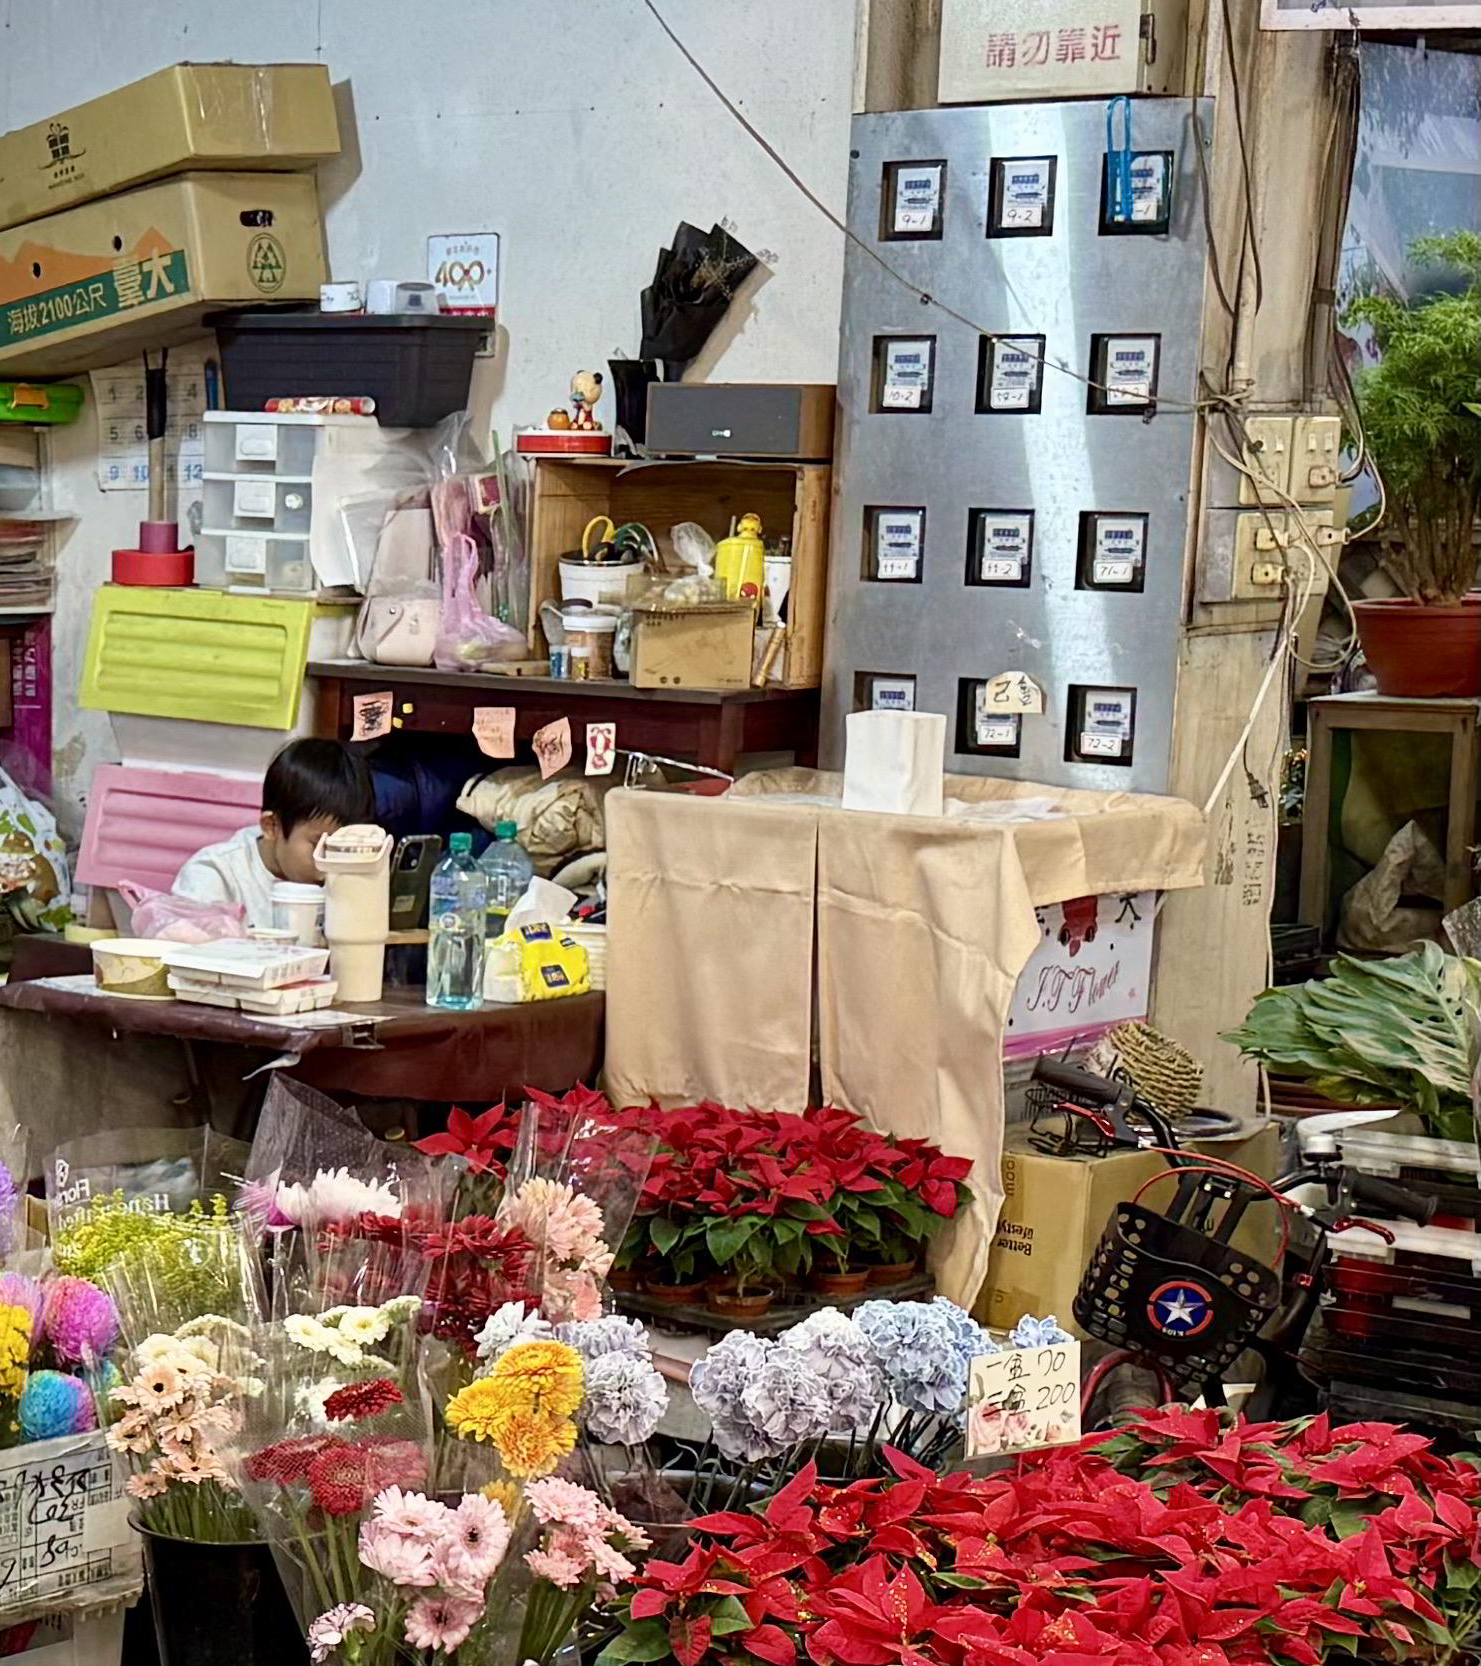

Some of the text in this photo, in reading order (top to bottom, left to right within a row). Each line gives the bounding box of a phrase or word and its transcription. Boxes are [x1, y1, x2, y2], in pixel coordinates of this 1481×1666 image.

[987, 25, 1121, 68] 請勿靠近
[1006, 209, 1034, 222] 9-2
[6, 282, 107, 335] 海拔2100公尺
[997, 1238, 1032, 1256] Better
[1037, 1349, 1066, 1376] 70
[1036, 1381, 1076, 1411] 200
